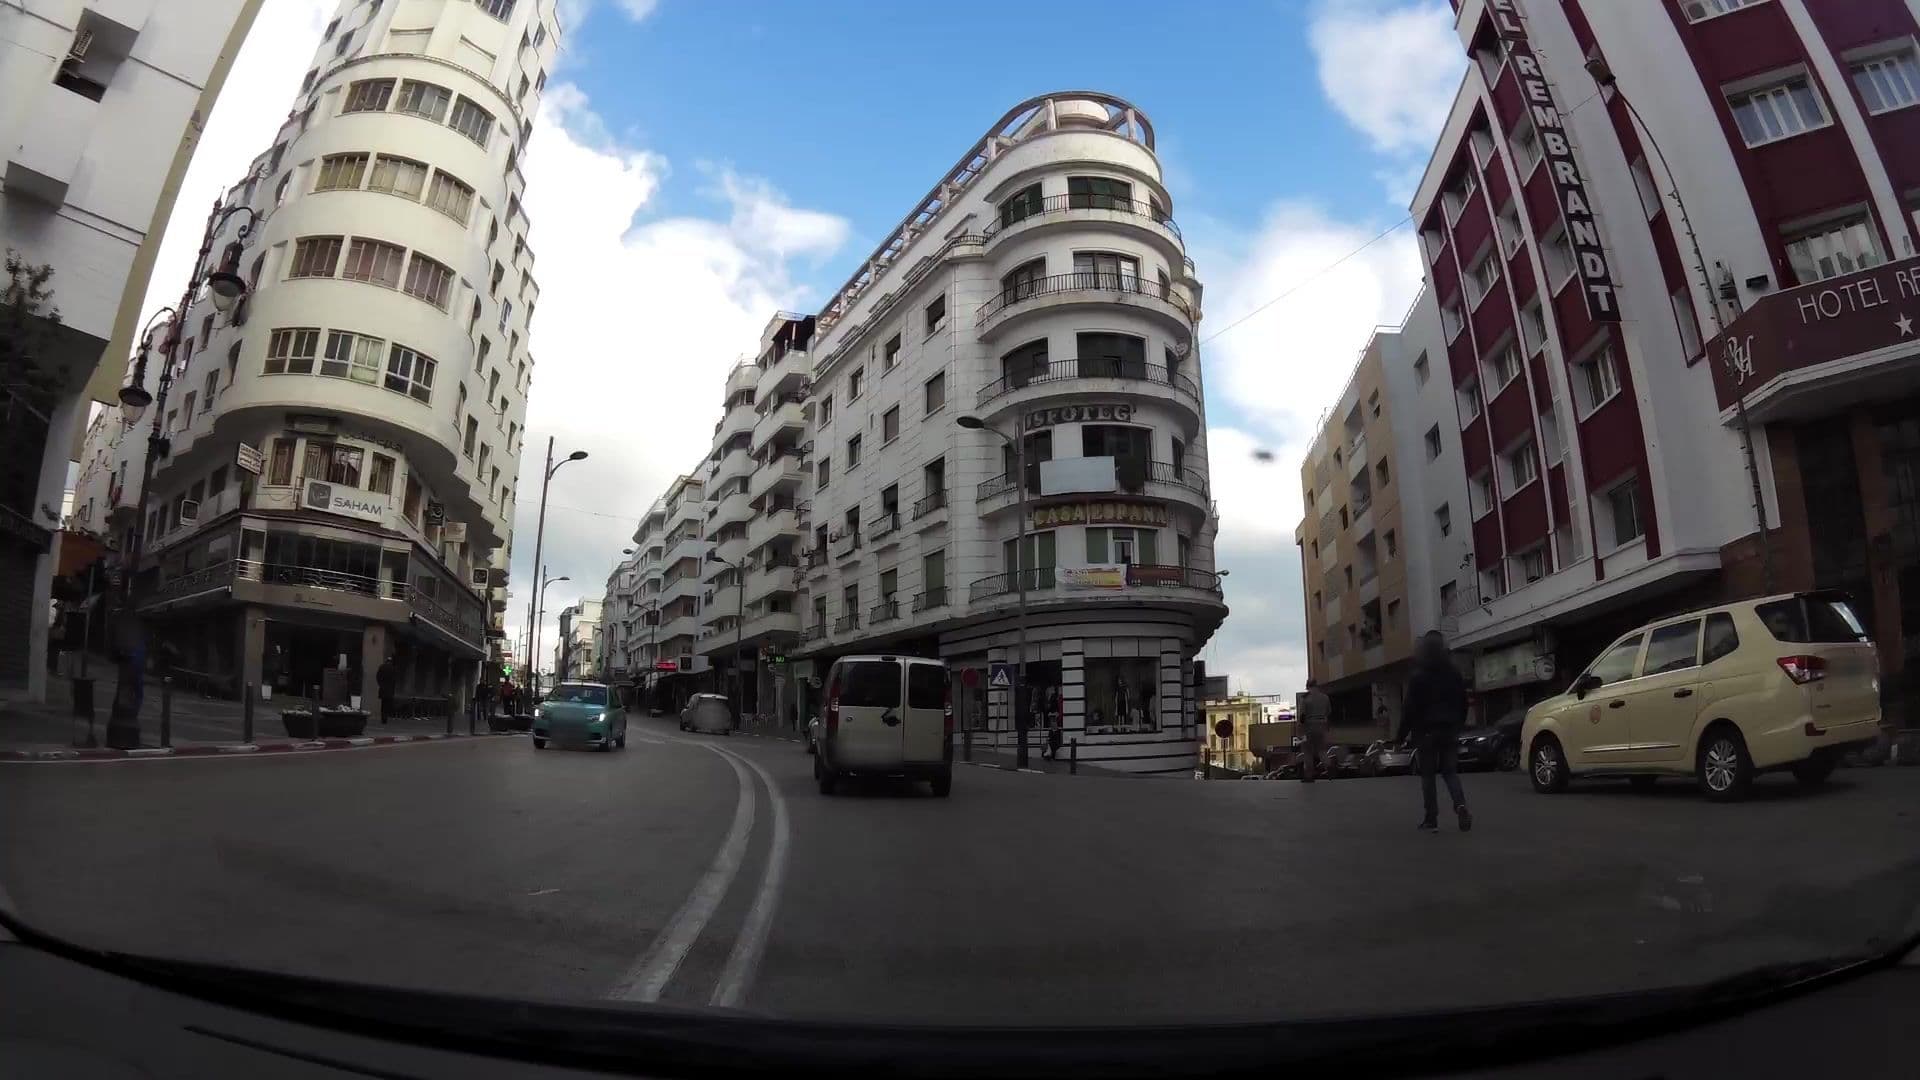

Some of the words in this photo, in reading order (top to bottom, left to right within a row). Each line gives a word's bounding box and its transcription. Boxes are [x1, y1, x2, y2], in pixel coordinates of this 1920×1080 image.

[1515, 55, 1611, 313] REMBRANDT
[1797, 277, 1888, 324] HOTEL
[333, 497, 382, 516] SAHAM
[1034, 504, 1084, 525] CASA
